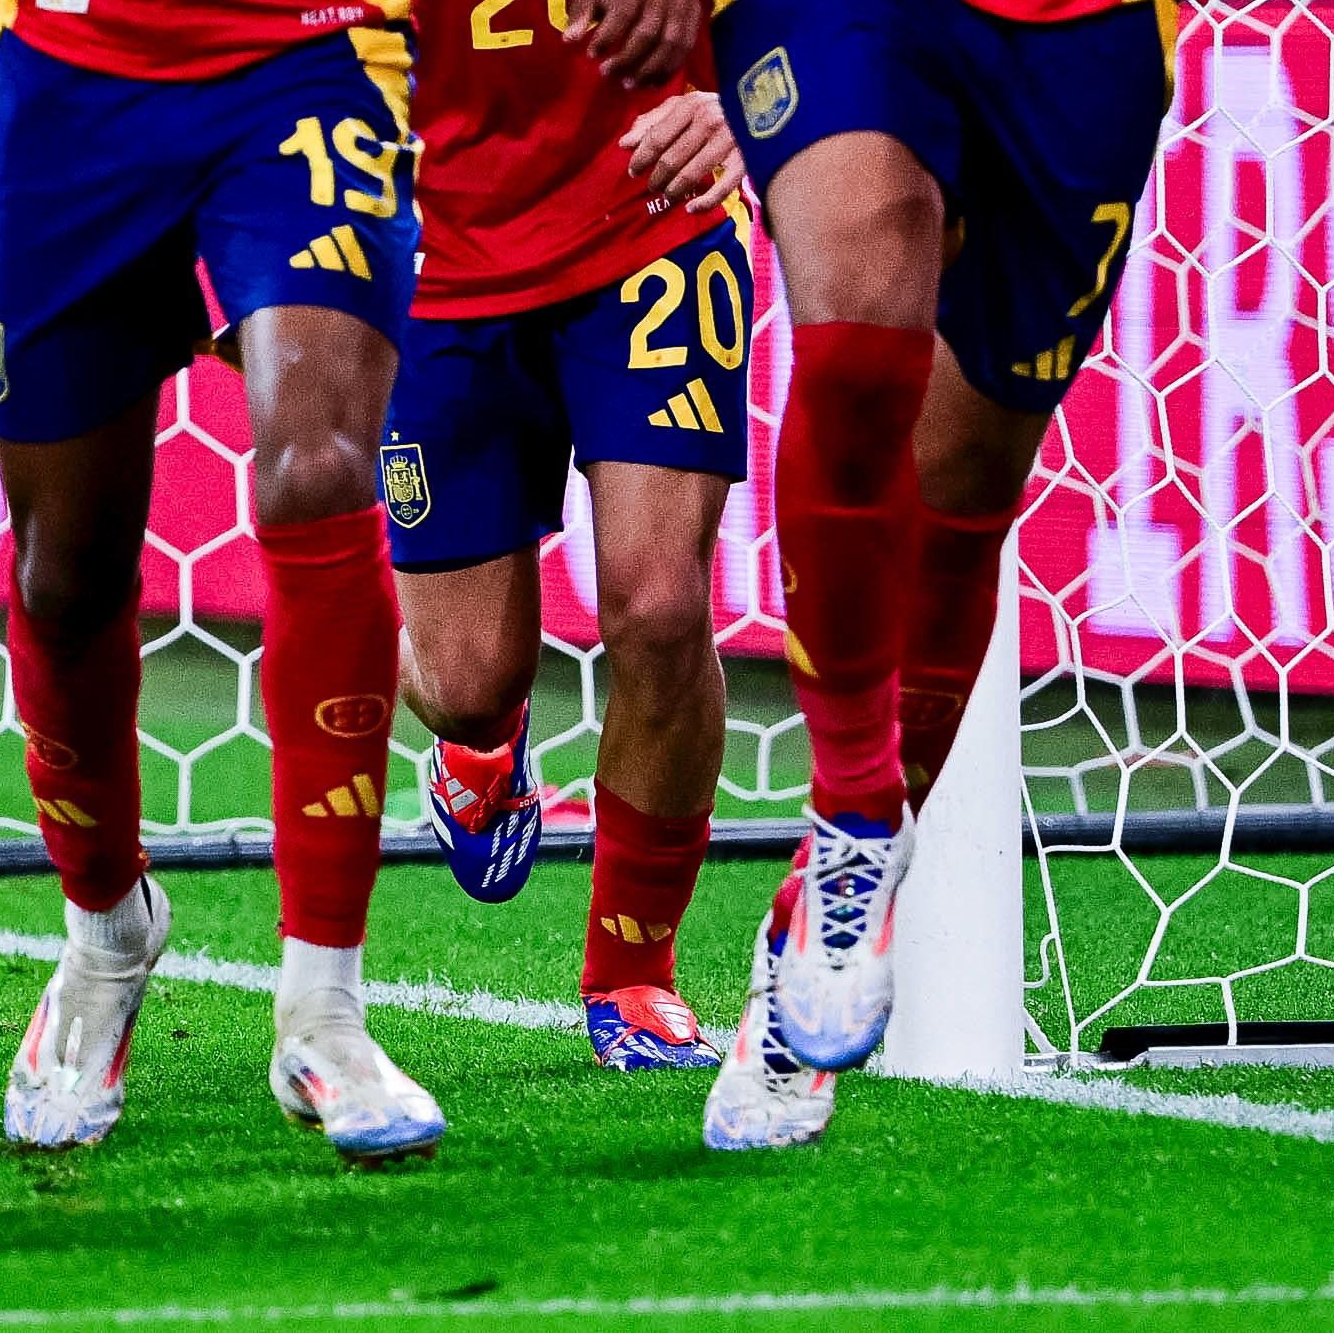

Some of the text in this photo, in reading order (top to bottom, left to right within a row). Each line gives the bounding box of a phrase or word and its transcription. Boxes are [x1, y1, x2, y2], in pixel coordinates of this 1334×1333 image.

[279, 116, 399, 218] 19
[620, 250, 744, 370] 20
[1067, 201, 1131, 318] 7
